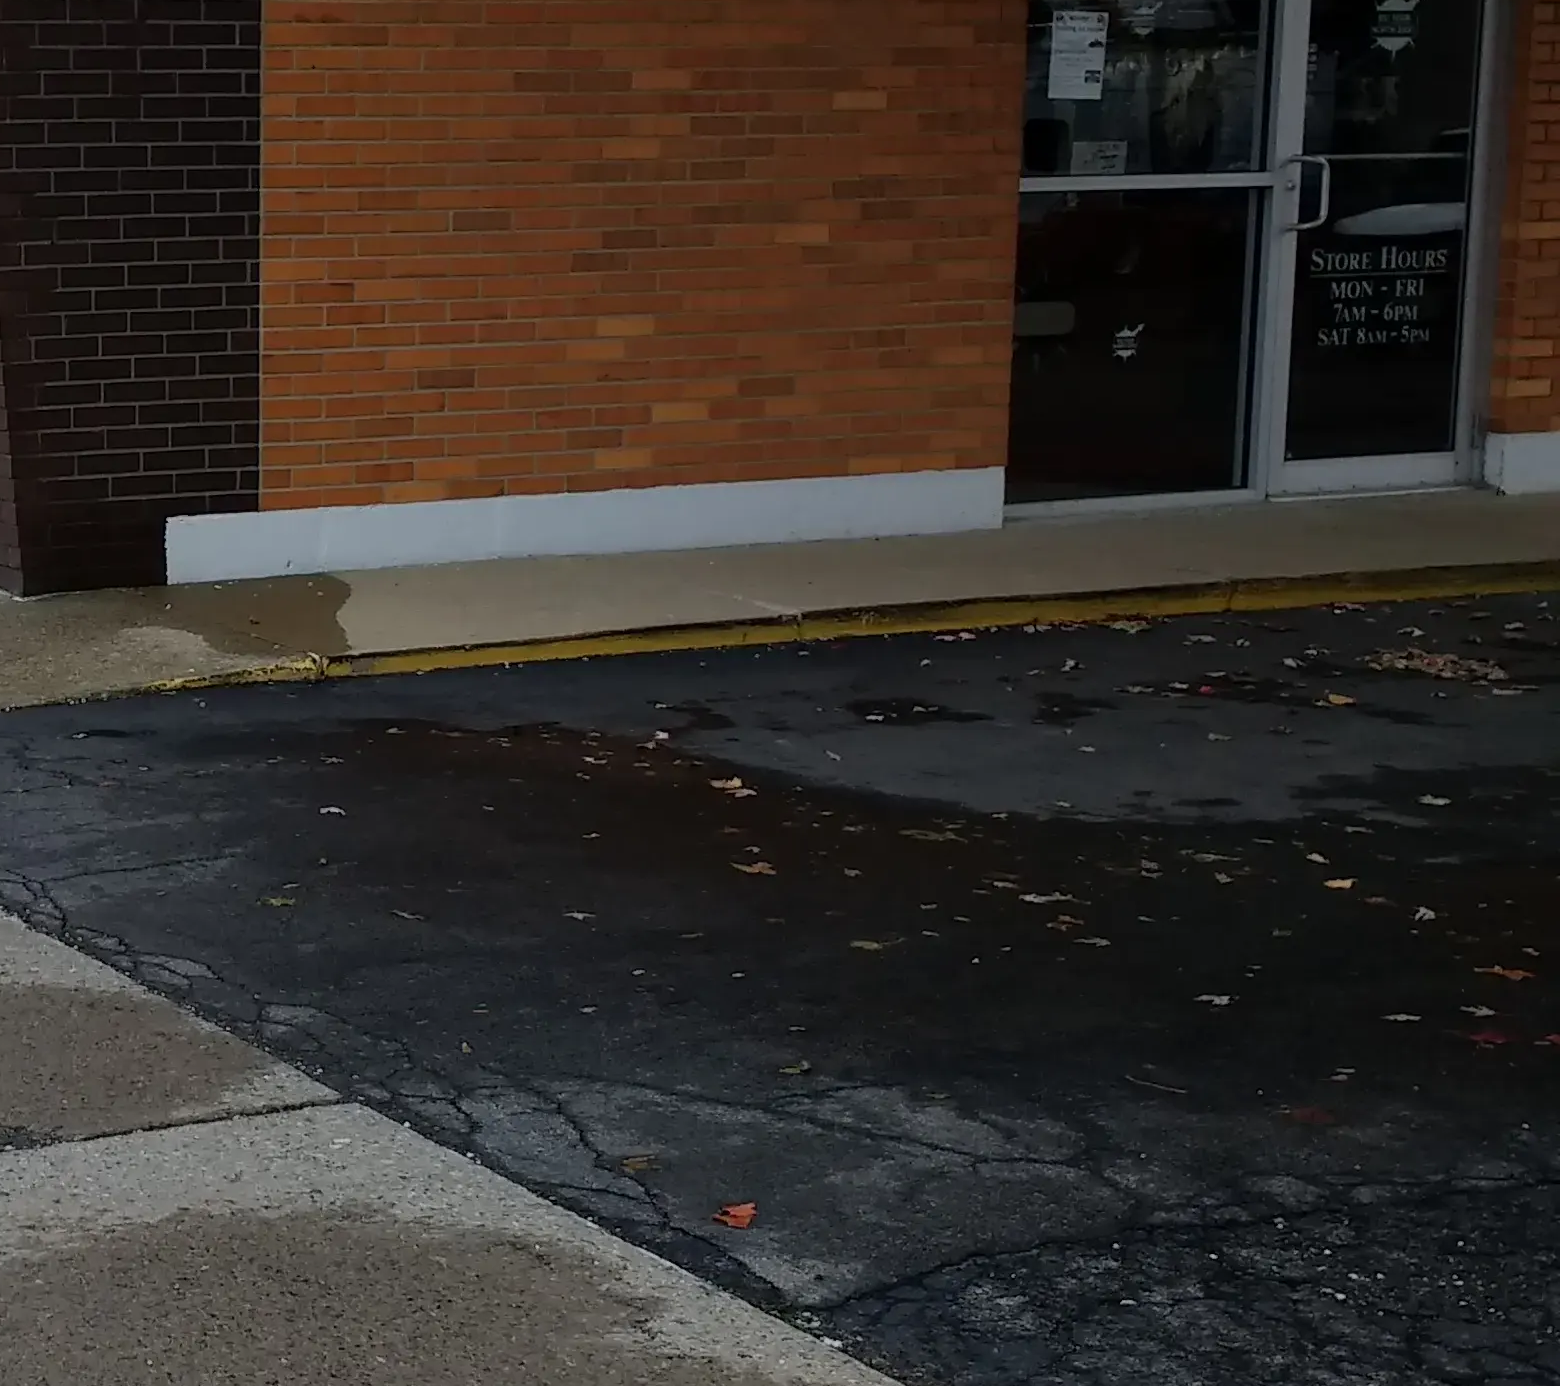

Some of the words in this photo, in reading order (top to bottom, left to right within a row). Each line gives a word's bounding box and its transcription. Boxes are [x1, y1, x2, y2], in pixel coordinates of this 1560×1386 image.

[1310, 248, 1372, 272] STORE
[1380, 246, 1448, 269] HOURS
[1330, 280, 1373, 300] MON
[1395, 278, 1424, 297] FRI
[1317, 328, 1351, 346] SAT
